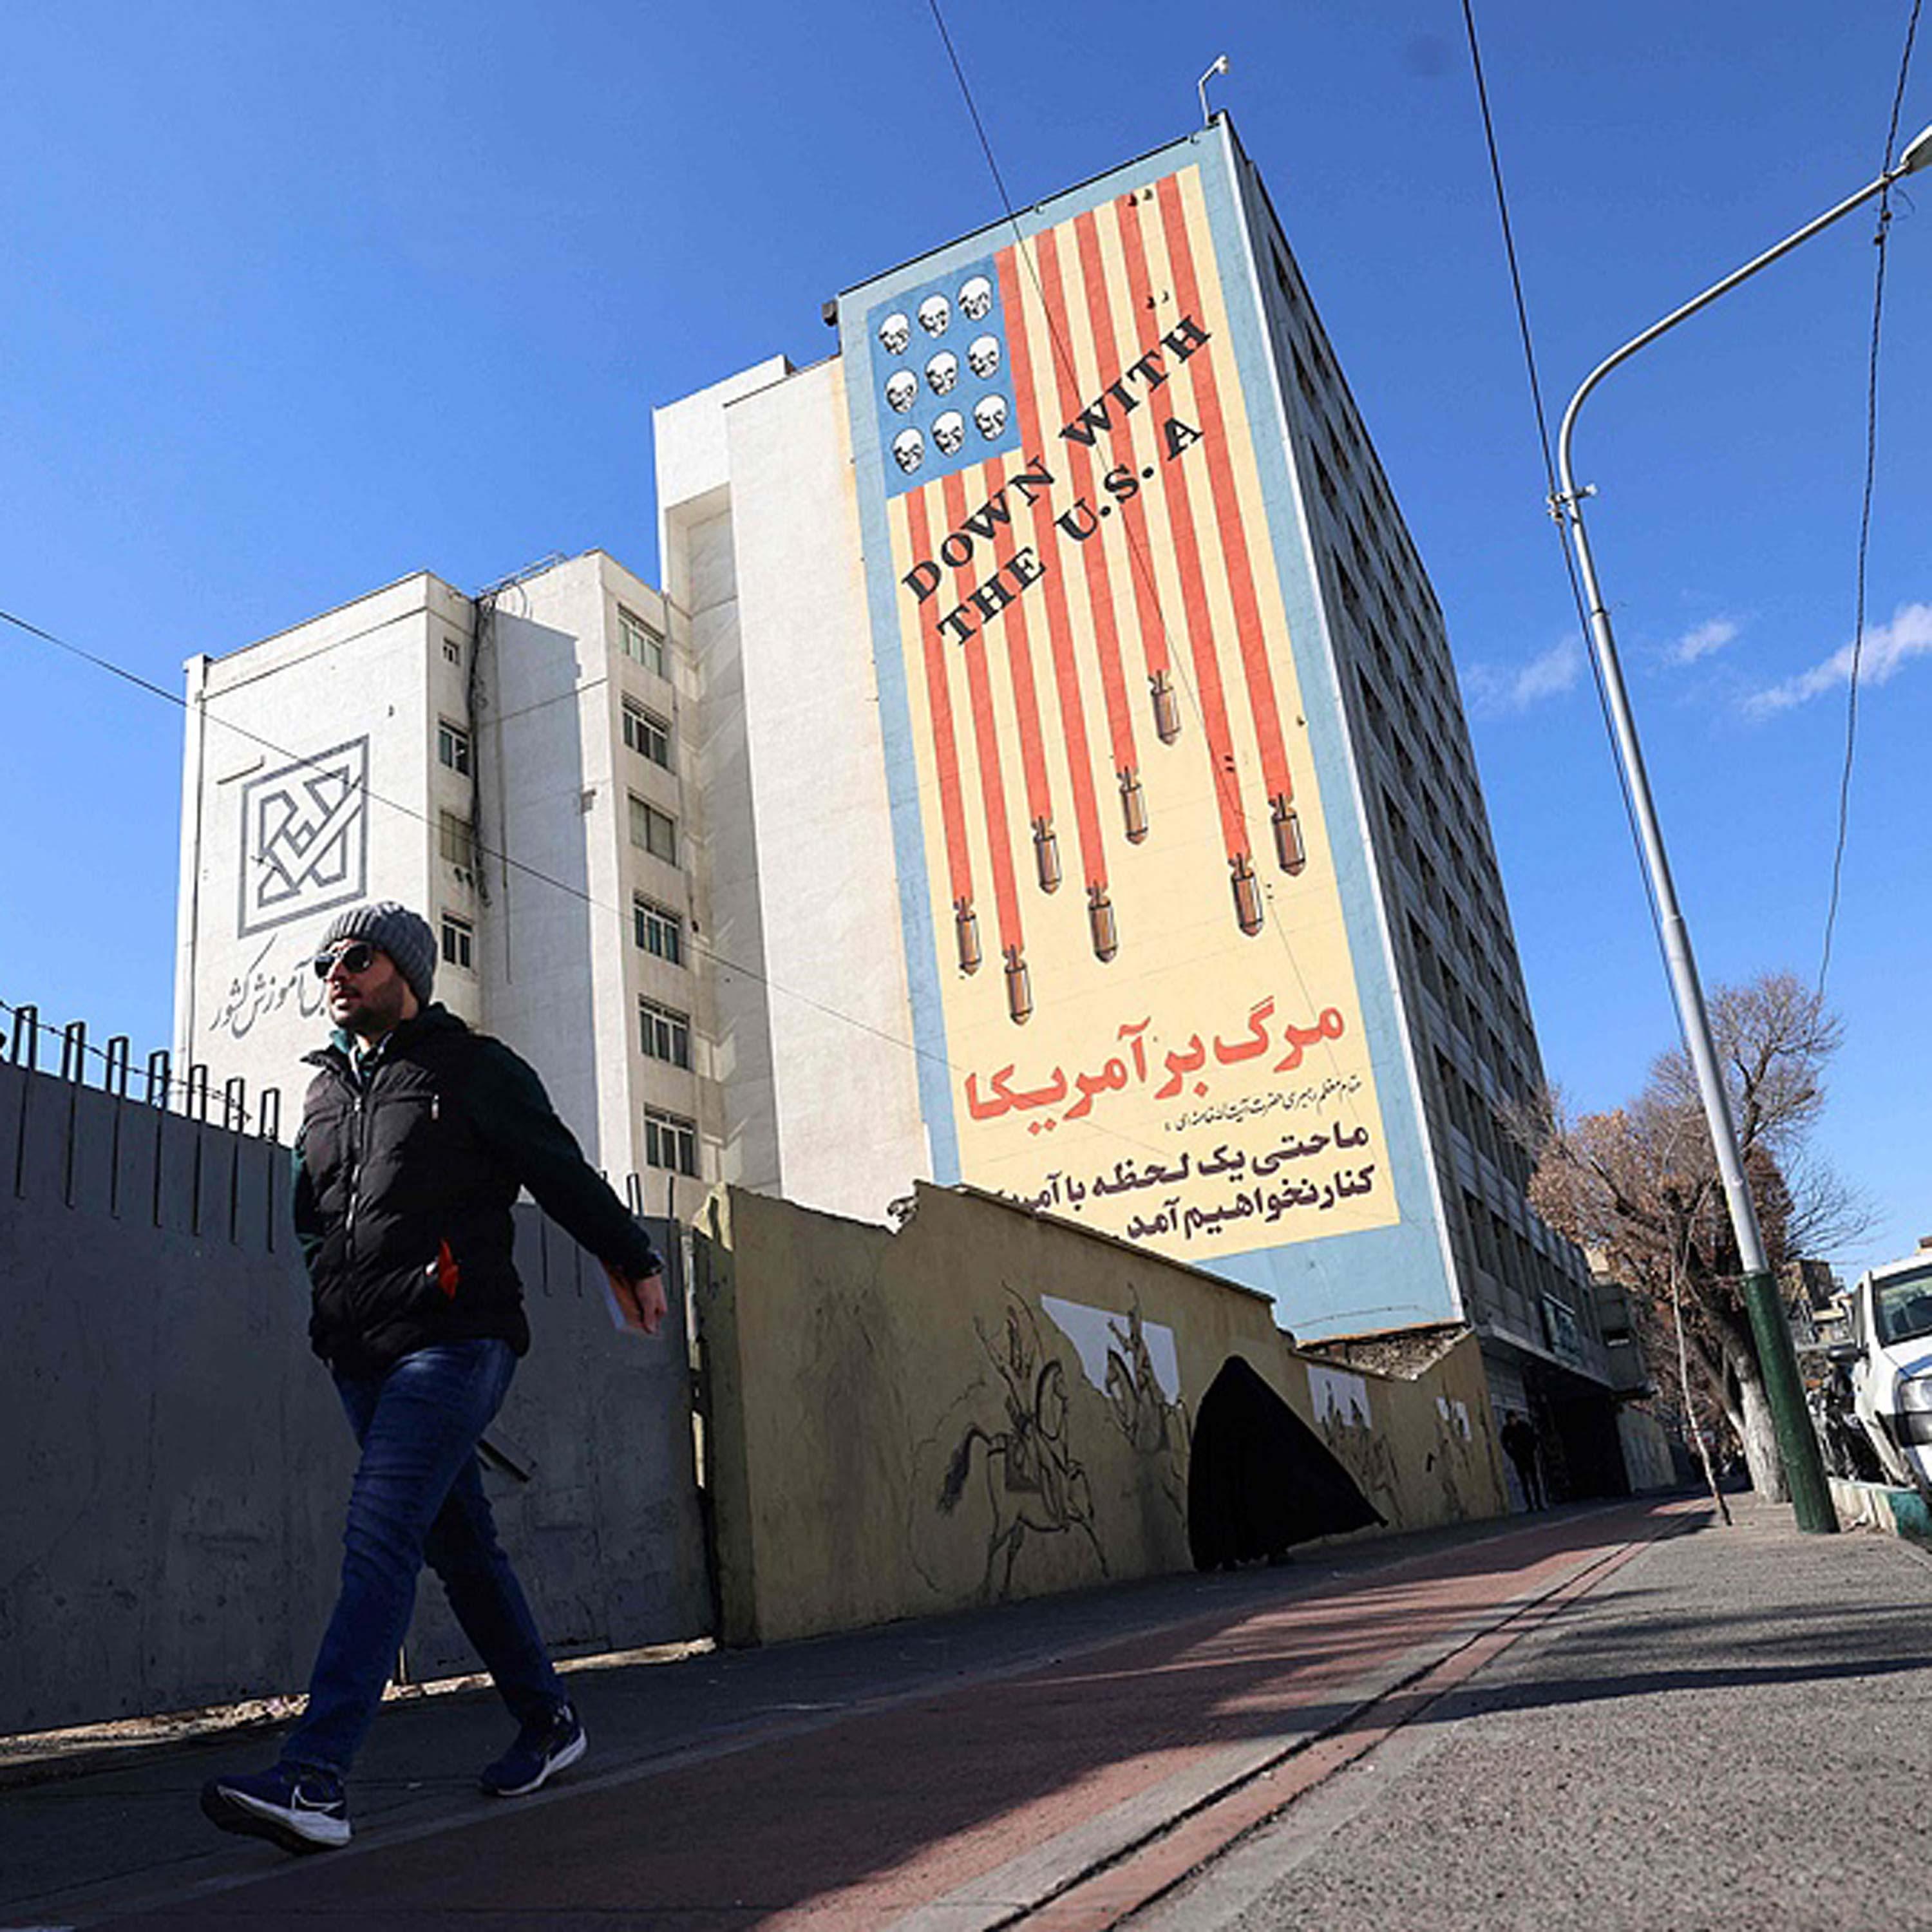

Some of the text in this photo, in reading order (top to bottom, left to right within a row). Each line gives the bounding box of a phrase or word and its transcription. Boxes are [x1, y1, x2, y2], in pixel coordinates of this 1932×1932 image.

[902, 315, 1211, 604] DOWN WITH
[936, 416, 1204, 645] THE U.S. A
[964, 995, 1345, 1135] مرگ بر آمریکا
[1252, 1134, 1331, 1176] حتی
[1332, 1121, 1369, 1148] ما
[1093, 1152, 1189, 1197] لحظه
[1197, 1144, 1245, 1182] یک
[1065, 1175, 1086, 1211] با
[1127, 1164, 1376, 1240] کنار نخواهیم آمد
